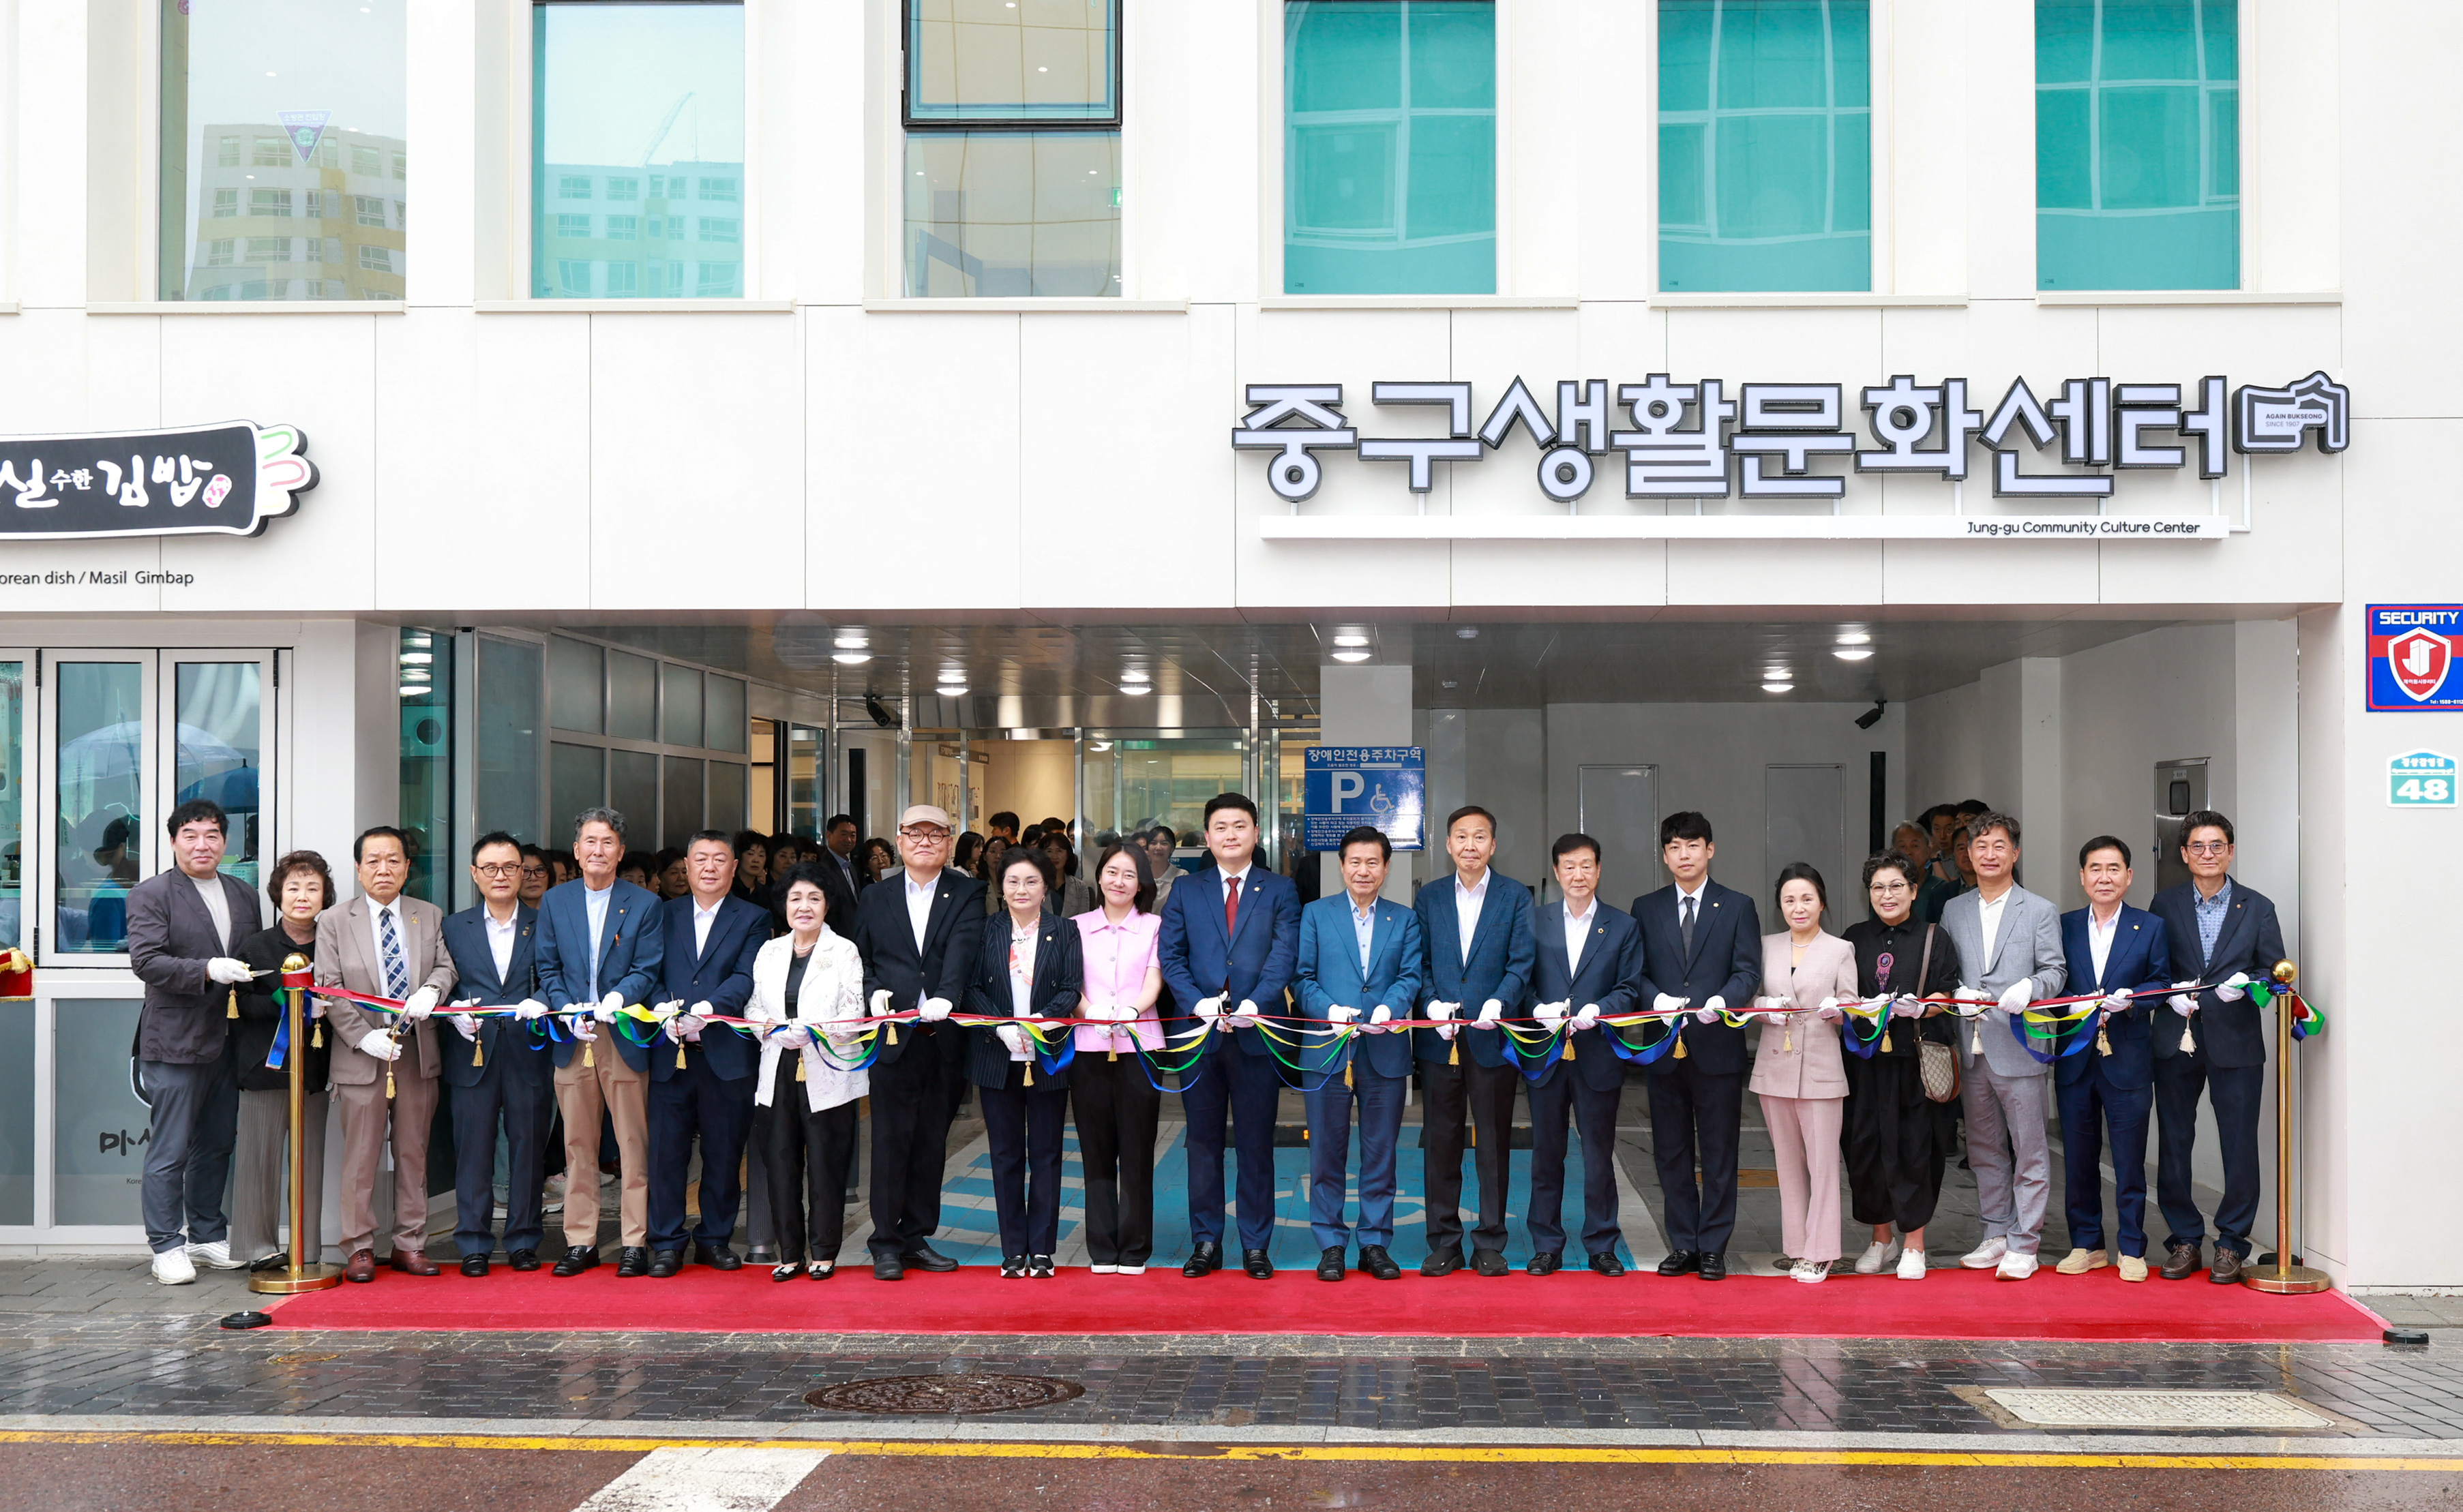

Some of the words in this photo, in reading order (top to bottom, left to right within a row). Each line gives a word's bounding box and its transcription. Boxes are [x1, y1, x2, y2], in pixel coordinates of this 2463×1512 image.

[1232, 373, 2227, 503] 중구생활문화센터
[49, 468, 93, 491] 수한
[96, 454, 213, 507] 김밥
[1967, 521, 2020, 535] Jung-gu
[2022, 521, 2098, 535] Community
[2100, 521, 2150, 533] Culture
[2153, 521, 2200, 533] Center
[44, 571, 75, 584] dish
[89, 571, 127, 584] Masil
[135, 571, 194, 586] Gimbap
[2379, 611, 2460, 625] SECURITY
[1308, 749, 1421, 762] 장애인전용주차구역
[1332, 771, 1364, 813] P
[2397, 778, 2449, 800] 48
